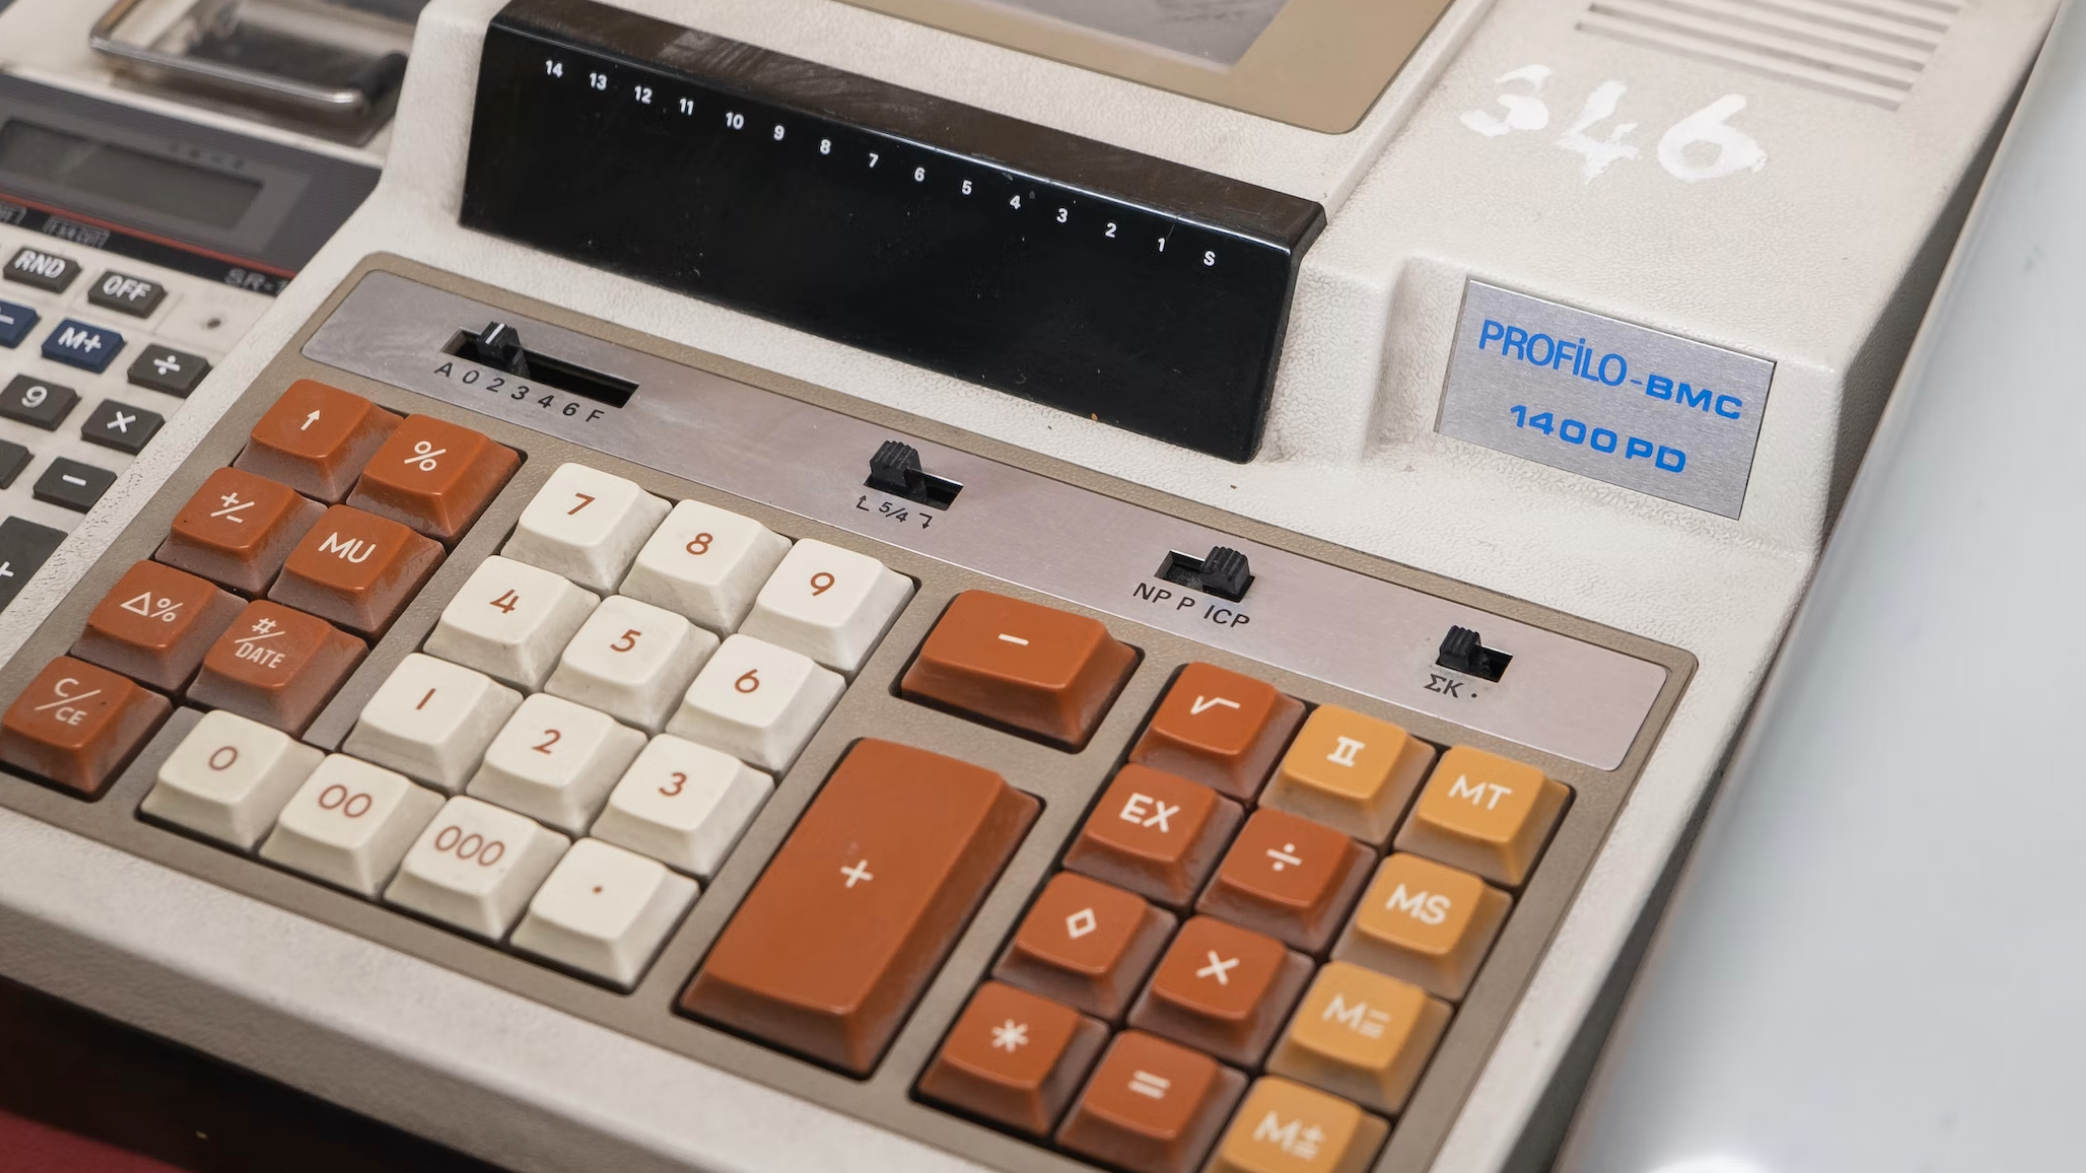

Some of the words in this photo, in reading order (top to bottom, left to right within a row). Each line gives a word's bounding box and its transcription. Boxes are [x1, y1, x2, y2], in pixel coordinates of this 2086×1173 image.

[1459, 64, 1768, 185] 346
[545, 59, 564, 78] 14
[589, 72, 608, 91] 13
[634, 85, 653, 104] 12
[679, 97, 694, 116] 11
[725, 111, 745, 130] 10
[773, 124, 785, 141] 9
[819, 138, 832, 155] 8
[869, 152, 879, 168] 7
[914, 166, 926, 182] 6
[961, 179, 973, 196] 5
[1009, 194, 1021, 210] 4
[1056, 207, 1068, 223] 3
[1104, 222, 1117, 239] 2
[1157, 237, 1166, 253] 1
[1203, 250, 1216, 267] S
[15, 251, 66, 279] RND
[103, 275, 151, 301] OFF
[58, 327, 102, 352] M+
[20, 385, 48, 408] 9
[433, 361, 453, 378] A
[462, 369, 480, 385] 0
[485, 377, 506, 393] 2
[510, 385, 530, 401] 3
[537, 394, 555, 409] 4
[562, 402, 580, 417] 6
[585, 408, 605, 423] F
[567, 492, 596, 516] 7
[878, 501, 909, 523] 5/4
[317, 531, 377, 564] MU
[685, 532, 714, 556] 8
[810, 571, 836, 597] 9
[489, 589, 520, 614] 4
[1132, 581, 1173, 604] NP
[1176, 596, 1196, 611] P
[1203, 604, 1251, 628] ICP
[609, 628, 642, 653] 5
[734, 668, 760, 694] 6
[532, 728, 562, 755] 2
[208, 745, 239, 772] 0
[658, 771, 688, 797] 3
[1448, 774, 1513, 810] MT
[317, 783, 373, 819] 00
[1119, 792, 1180, 833] EX
[434, 826, 505, 866] 000
[1386, 883, 1451, 925] MS
